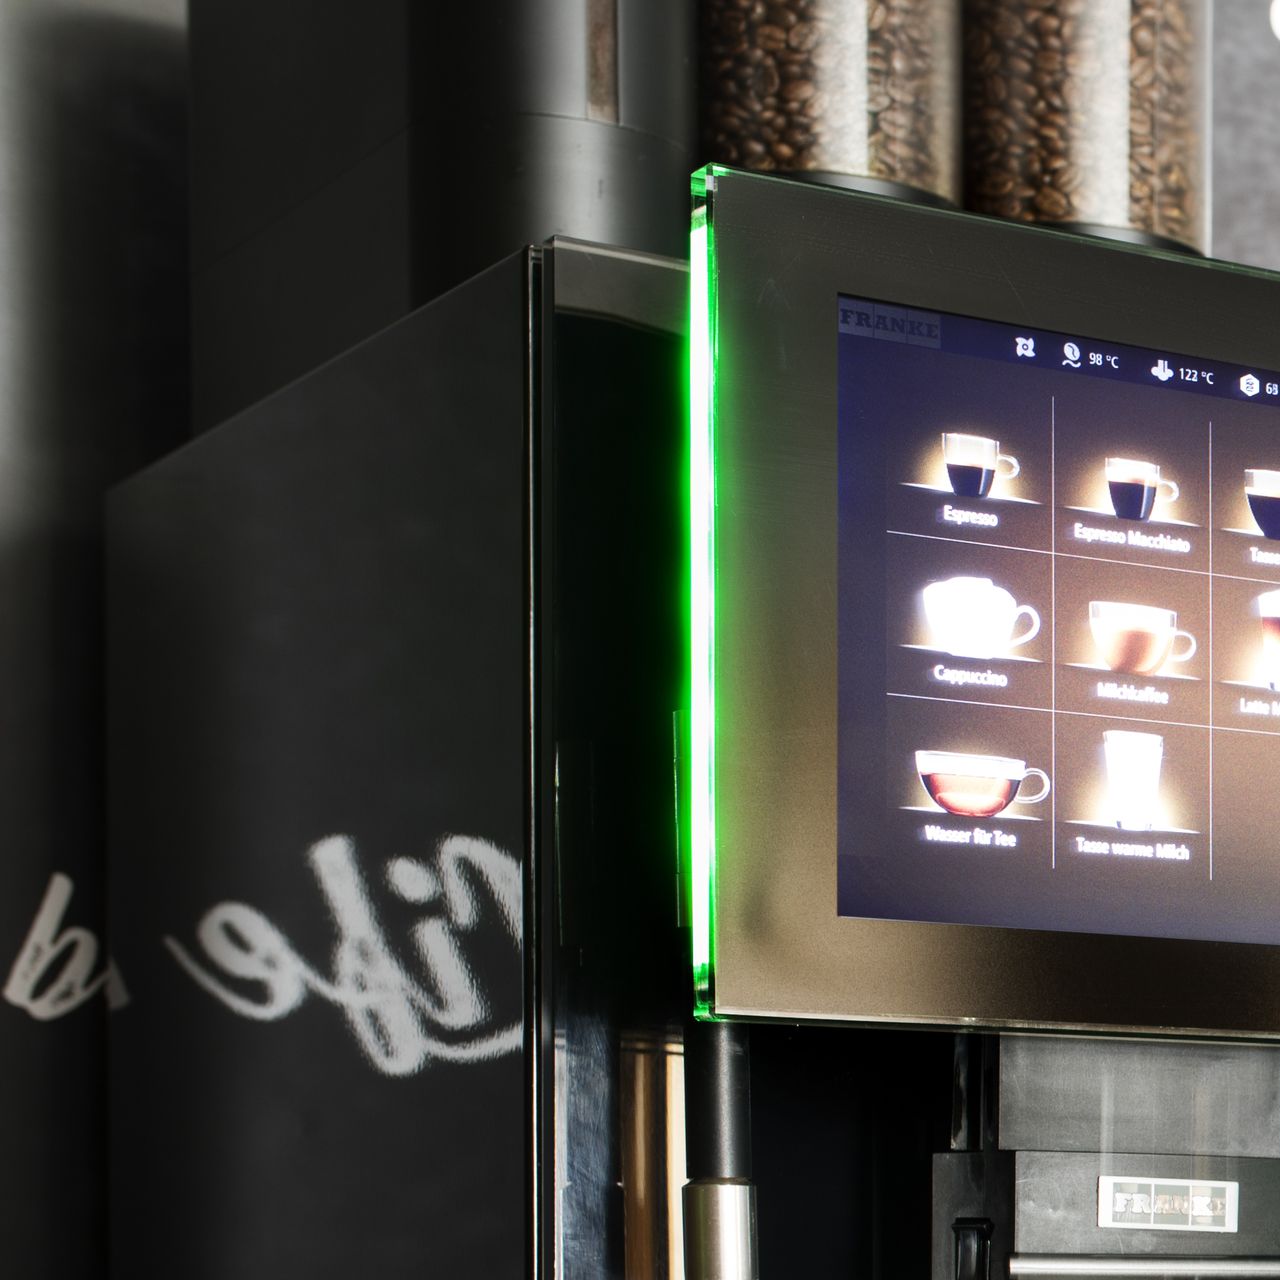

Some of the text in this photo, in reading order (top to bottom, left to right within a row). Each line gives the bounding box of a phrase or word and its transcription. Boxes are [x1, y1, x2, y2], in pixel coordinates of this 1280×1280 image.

[839, 307, 941, 339] FRANKE
[1088, 352, 1103, 366] 98
[943, 504, 999, 528] Espresso
[1073, 522, 1191, 553] Espresso Macchiato
[933, 664, 1008, 688] Cappuccino
[924, 825, 1017, 848] Wasser für Tee
[1155, 843, 1190, 860] Milch
[1112, 1191, 1227, 1217] FRANKE
